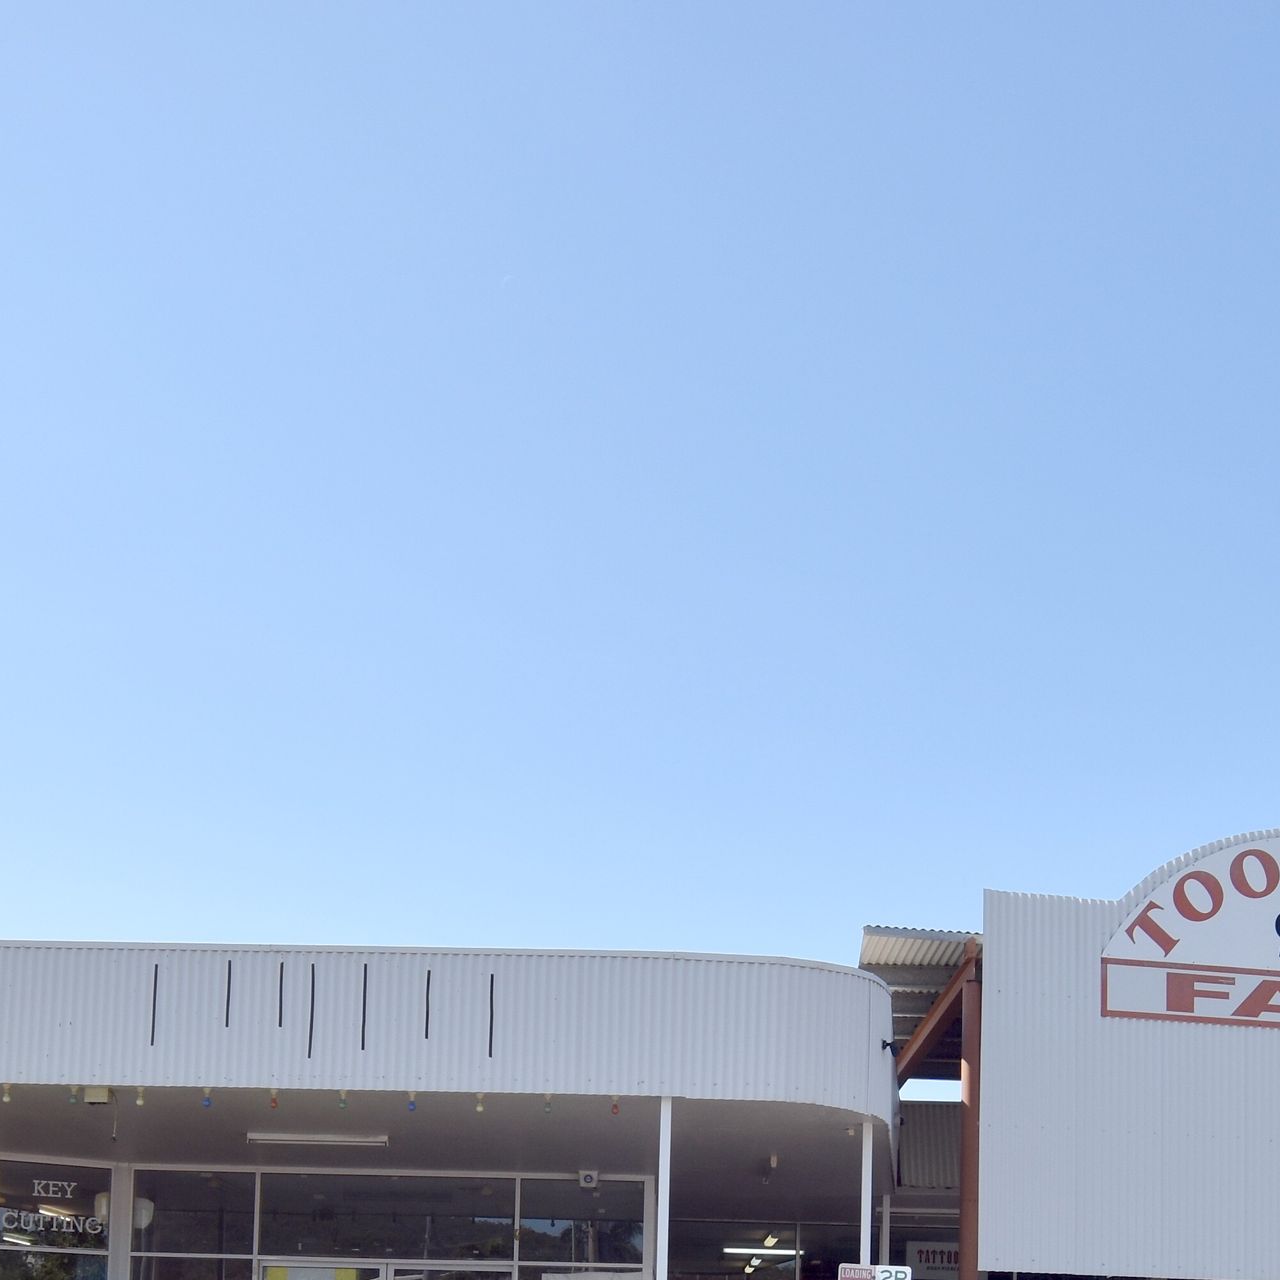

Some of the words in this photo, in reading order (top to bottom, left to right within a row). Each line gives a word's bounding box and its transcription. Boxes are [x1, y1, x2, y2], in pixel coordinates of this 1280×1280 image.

[32, 1179, 78, 1199] KEY
[1, 1211, 103, 1234] CUTTING
[841, 1269, 871, 1279] LOADING
